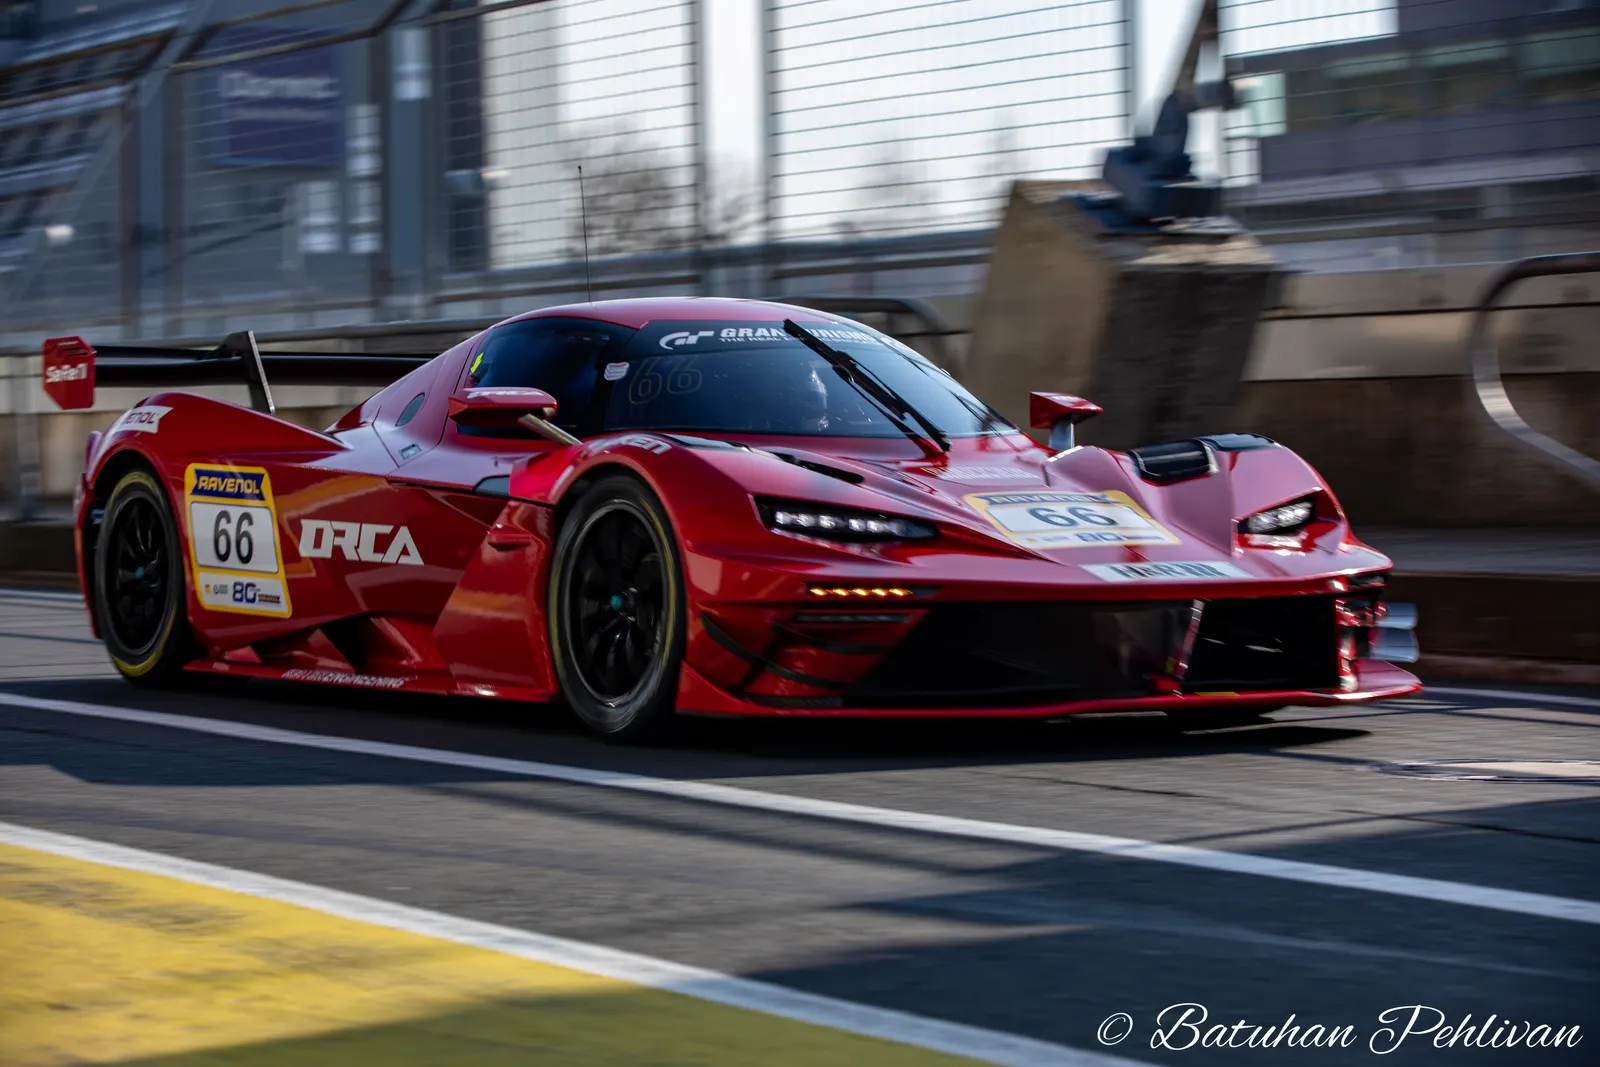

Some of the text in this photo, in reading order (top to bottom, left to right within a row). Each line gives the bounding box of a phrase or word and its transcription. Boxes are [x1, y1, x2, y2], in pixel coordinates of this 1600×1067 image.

[720, 327, 788, 338] GRAN
[628, 353, 704, 405] 66
[198, 475, 261, 495] RAVENOL
[1028, 506, 1119, 528] 66
[214, 509, 254, 564] 66
[298, 518, 425, 566] ORCA
